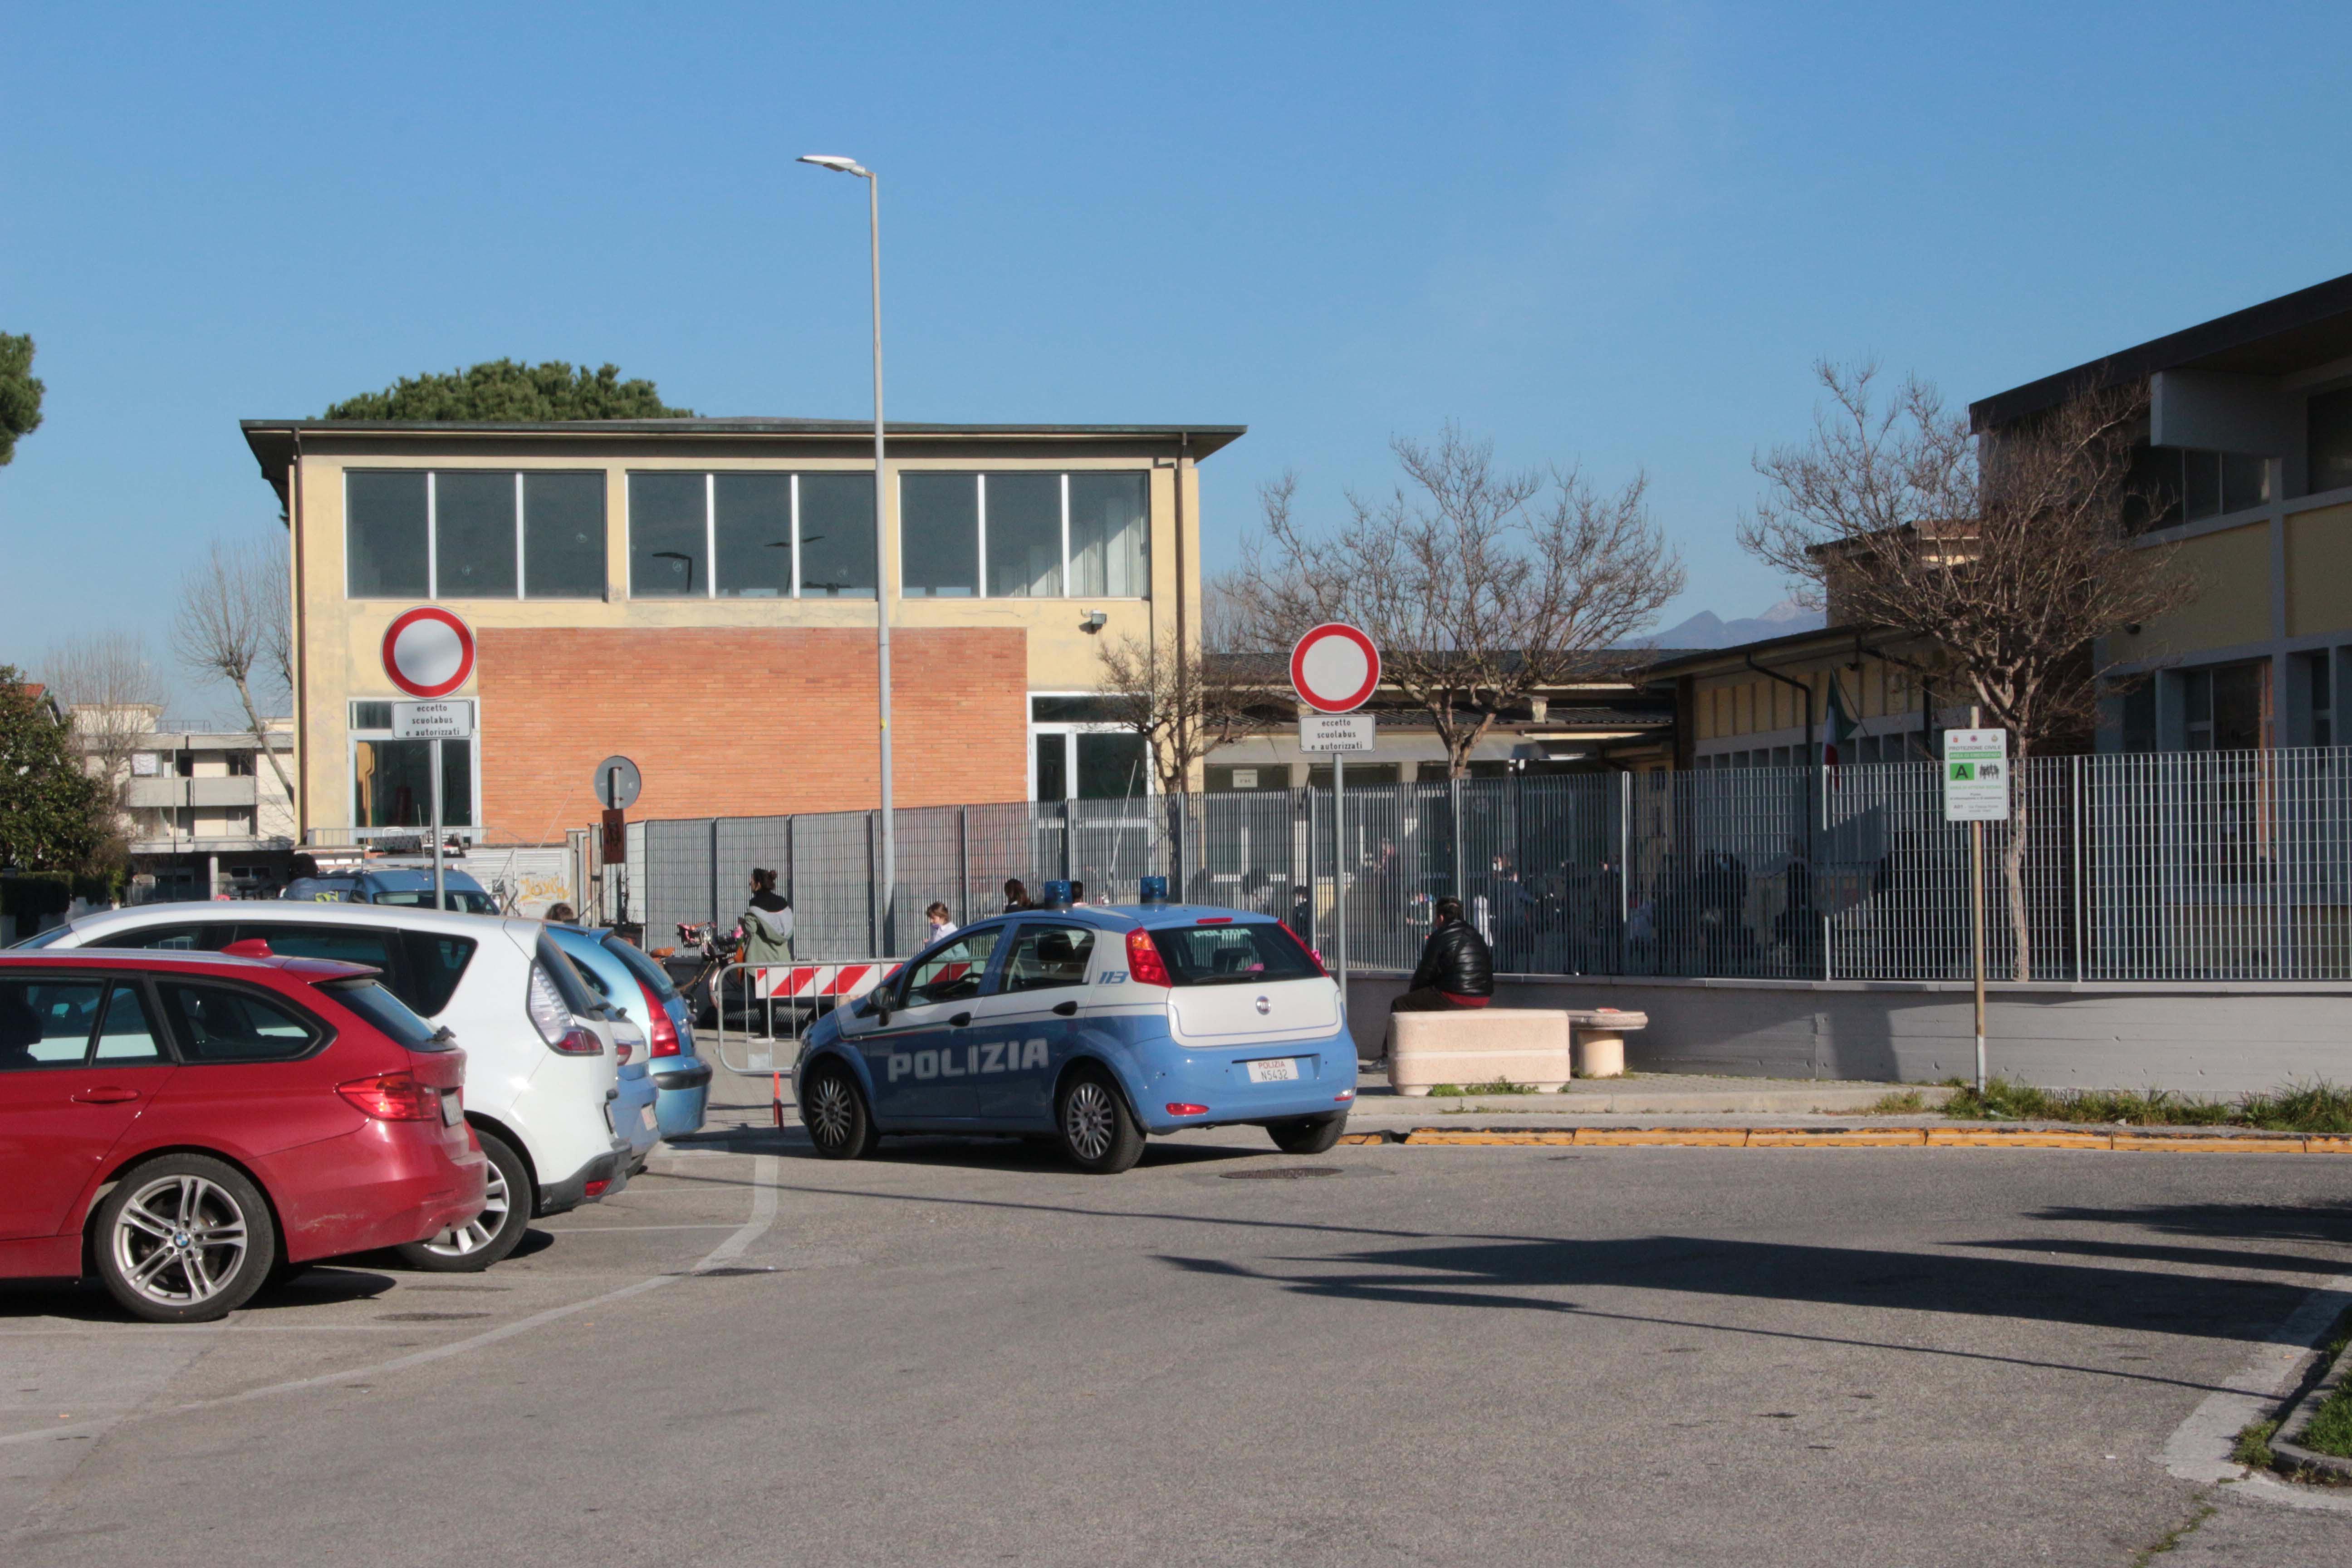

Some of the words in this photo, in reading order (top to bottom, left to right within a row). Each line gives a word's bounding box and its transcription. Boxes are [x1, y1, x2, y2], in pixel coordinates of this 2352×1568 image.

[412, 716, 453, 724] scuolabus
[1322, 718, 1351, 726] eccetto
[416, 727, 460, 736] autorizzati
[1321, 741, 1362, 750] autorizzati
[1955, 764, 1968, 779] A
[1193, 928, 1252, 938] POLIZIA
[1098, 971, 1129, 984] 113
[887, 1038, 1049, 1083] POLIZIA
[1258, 1061, 1285, 1069] POLIZIA
[1261, 1069, 1289, 1081] N5432
